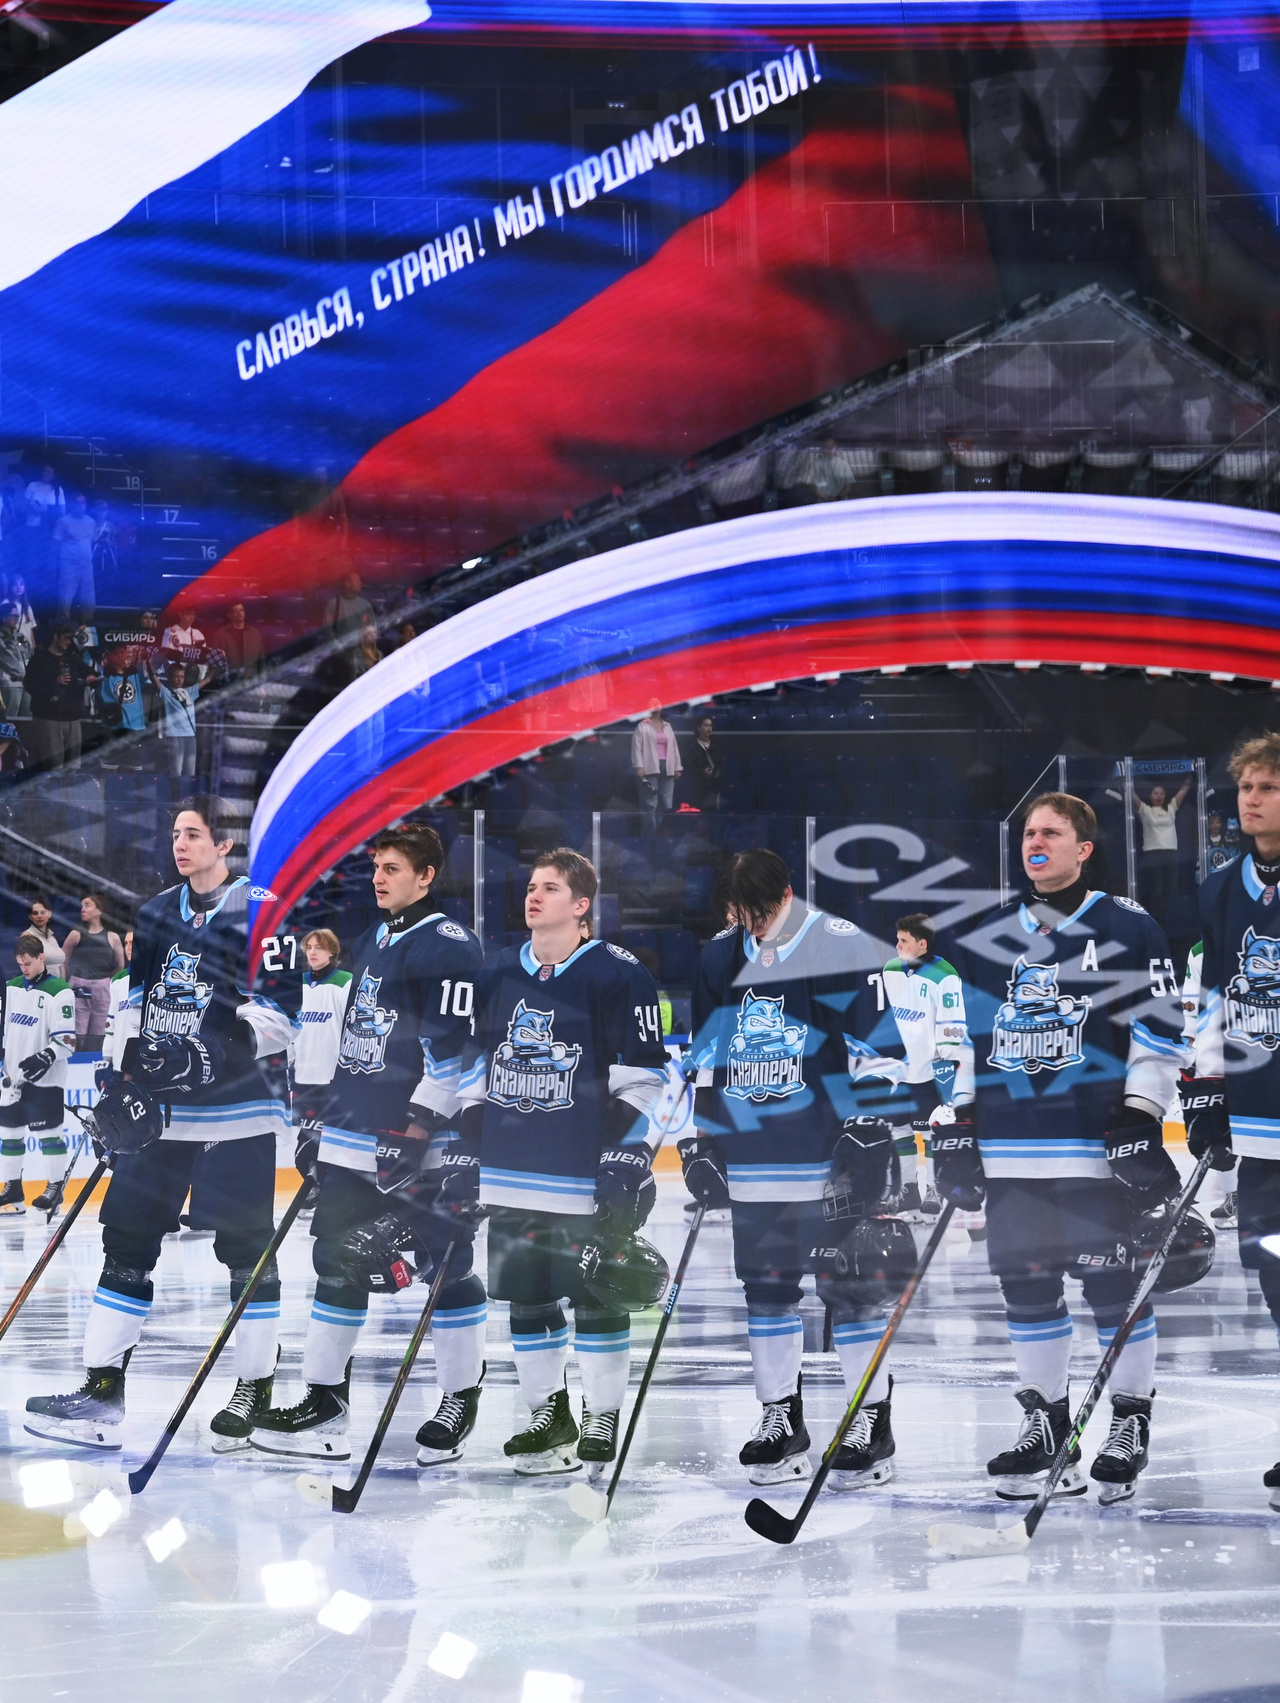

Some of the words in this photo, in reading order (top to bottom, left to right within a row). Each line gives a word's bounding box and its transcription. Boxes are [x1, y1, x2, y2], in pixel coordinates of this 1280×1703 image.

[236, 285, 365, 381] СЛАВЬСЯ,
[370, 216, 486, 311] СТРАНА!
[494, 187, 545, 247] МЫ
[550, 103, 704, 218] ГОРДИМСЯ
[709, 43, 821, 132] ТОБОЙ!
[125, 476, 140, 488] 18
[163, 510, 179, 522] 17
[201, 546, 217, 559] 16
[104, 632, 156, 644] СИБИРЬ
[183, 647, 201, 659] BIR
[261, 936, 297, 972] 27
[1081, 940, 1099, 971] A
[1149, 958, 1180, 997] 53
[440, 979, 474, 1017] 10
[920, 983, 928, 998] A
[942, 992, 960, 1009] 67
[10, 1011, 39, 1027] ОЛПАР
[302, 1011, 332, 1024] ОЛПАР
[891, 1006, 926, 1022] ОЛПАР
[1232, 999, 1280, 1033] СНАЙП
[635, 1005, 660, 1043] 34
[1182, 1093, 1224, 1111] UER
[844, 1116, 894, 1131] CCM
[933, 1137, 973, 1151] UER
[1106, 1139, 1148, 1160] UER
[440, 1154, 480, 1168] AUER
[600, 1150, 645, 1168] AUER
[1077, 1254, 1117, 1267] BAU
[293, 1412, 318, 1426] BAUER
